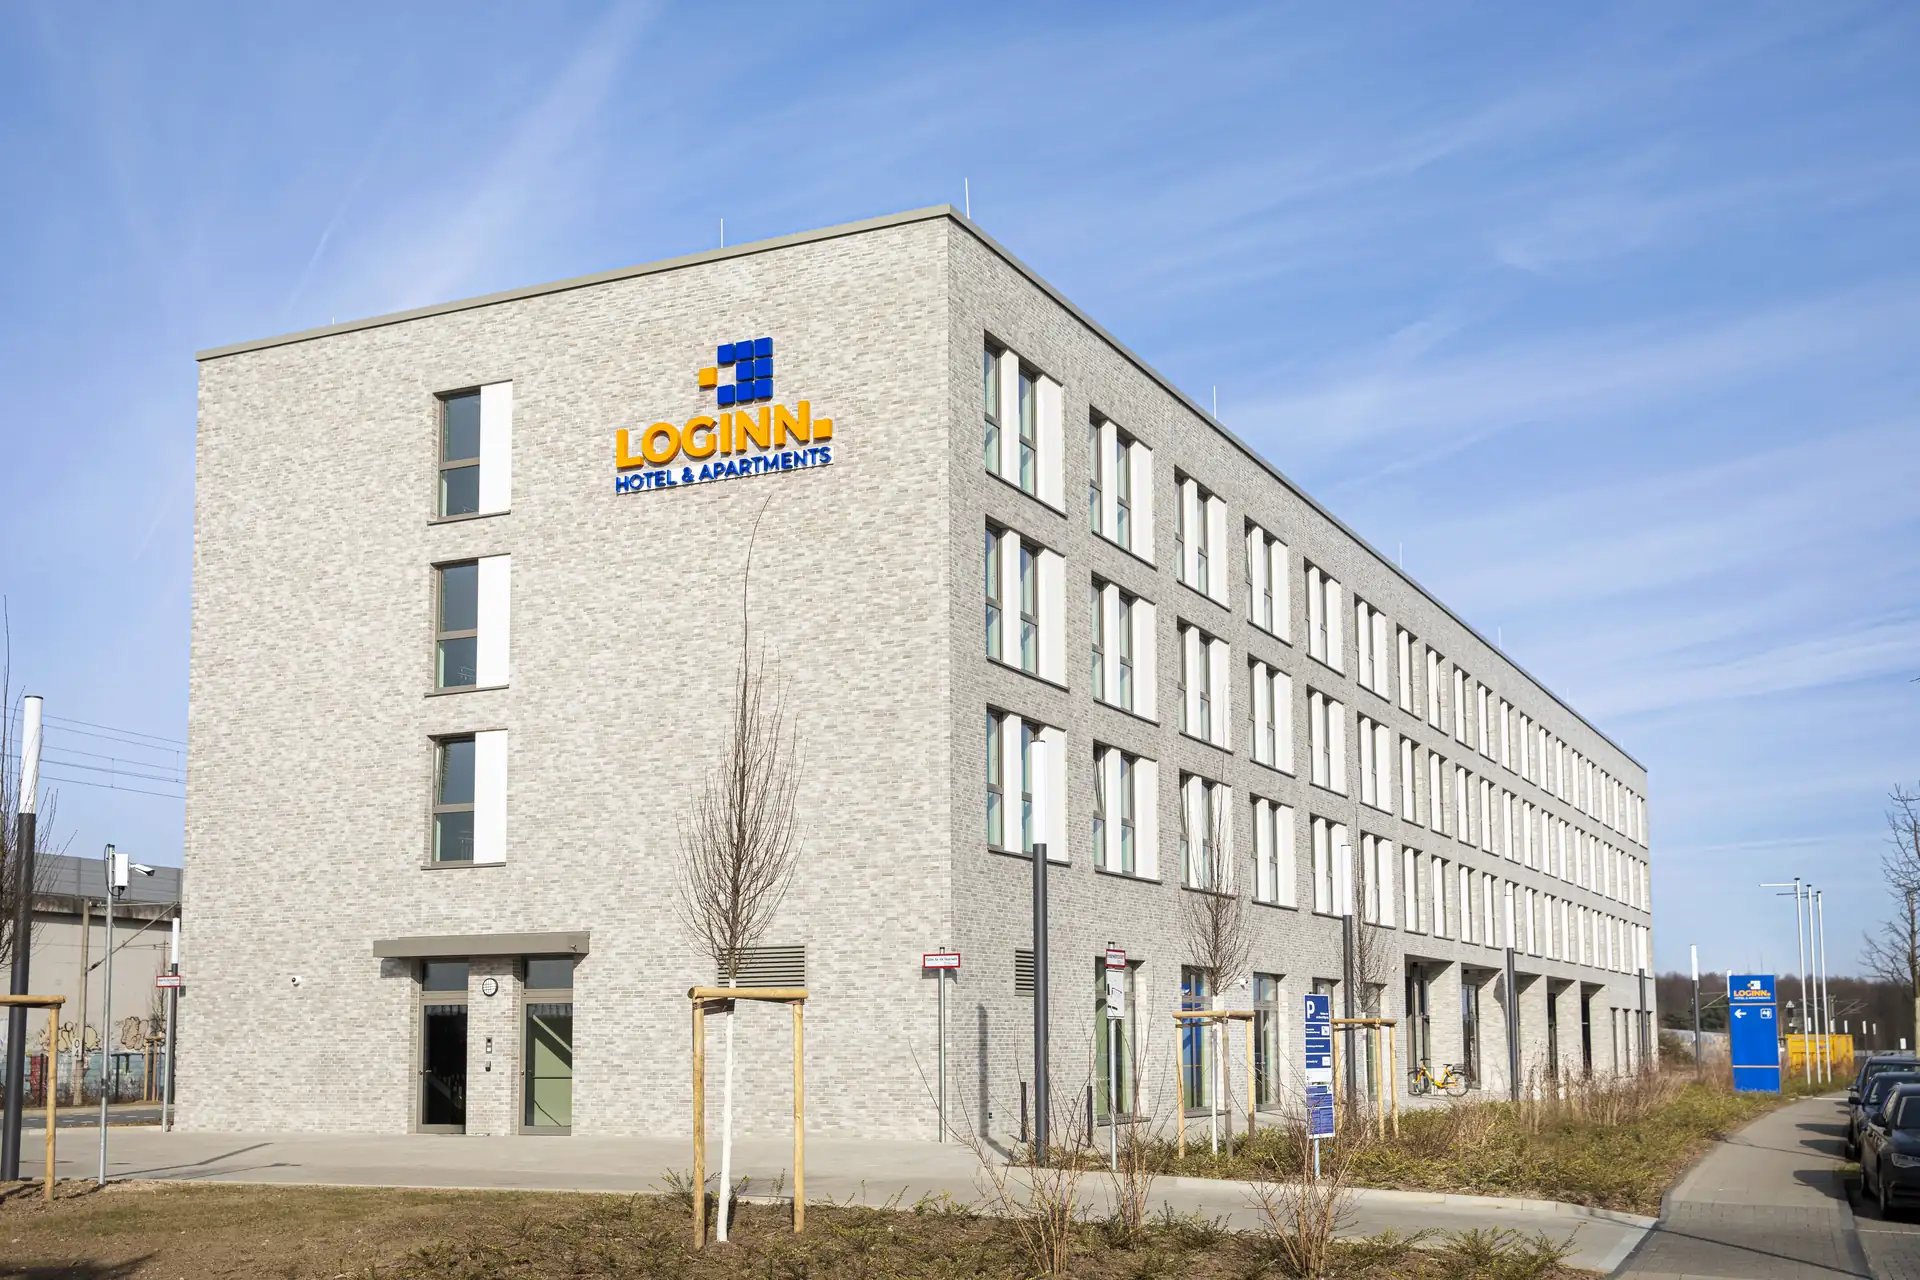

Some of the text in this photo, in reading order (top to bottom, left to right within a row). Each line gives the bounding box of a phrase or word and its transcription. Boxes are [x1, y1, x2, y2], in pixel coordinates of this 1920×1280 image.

[615, 446, 832, 494] HOTEL & APARTMENTS
[1306, 1000, 1315, 1019] P
